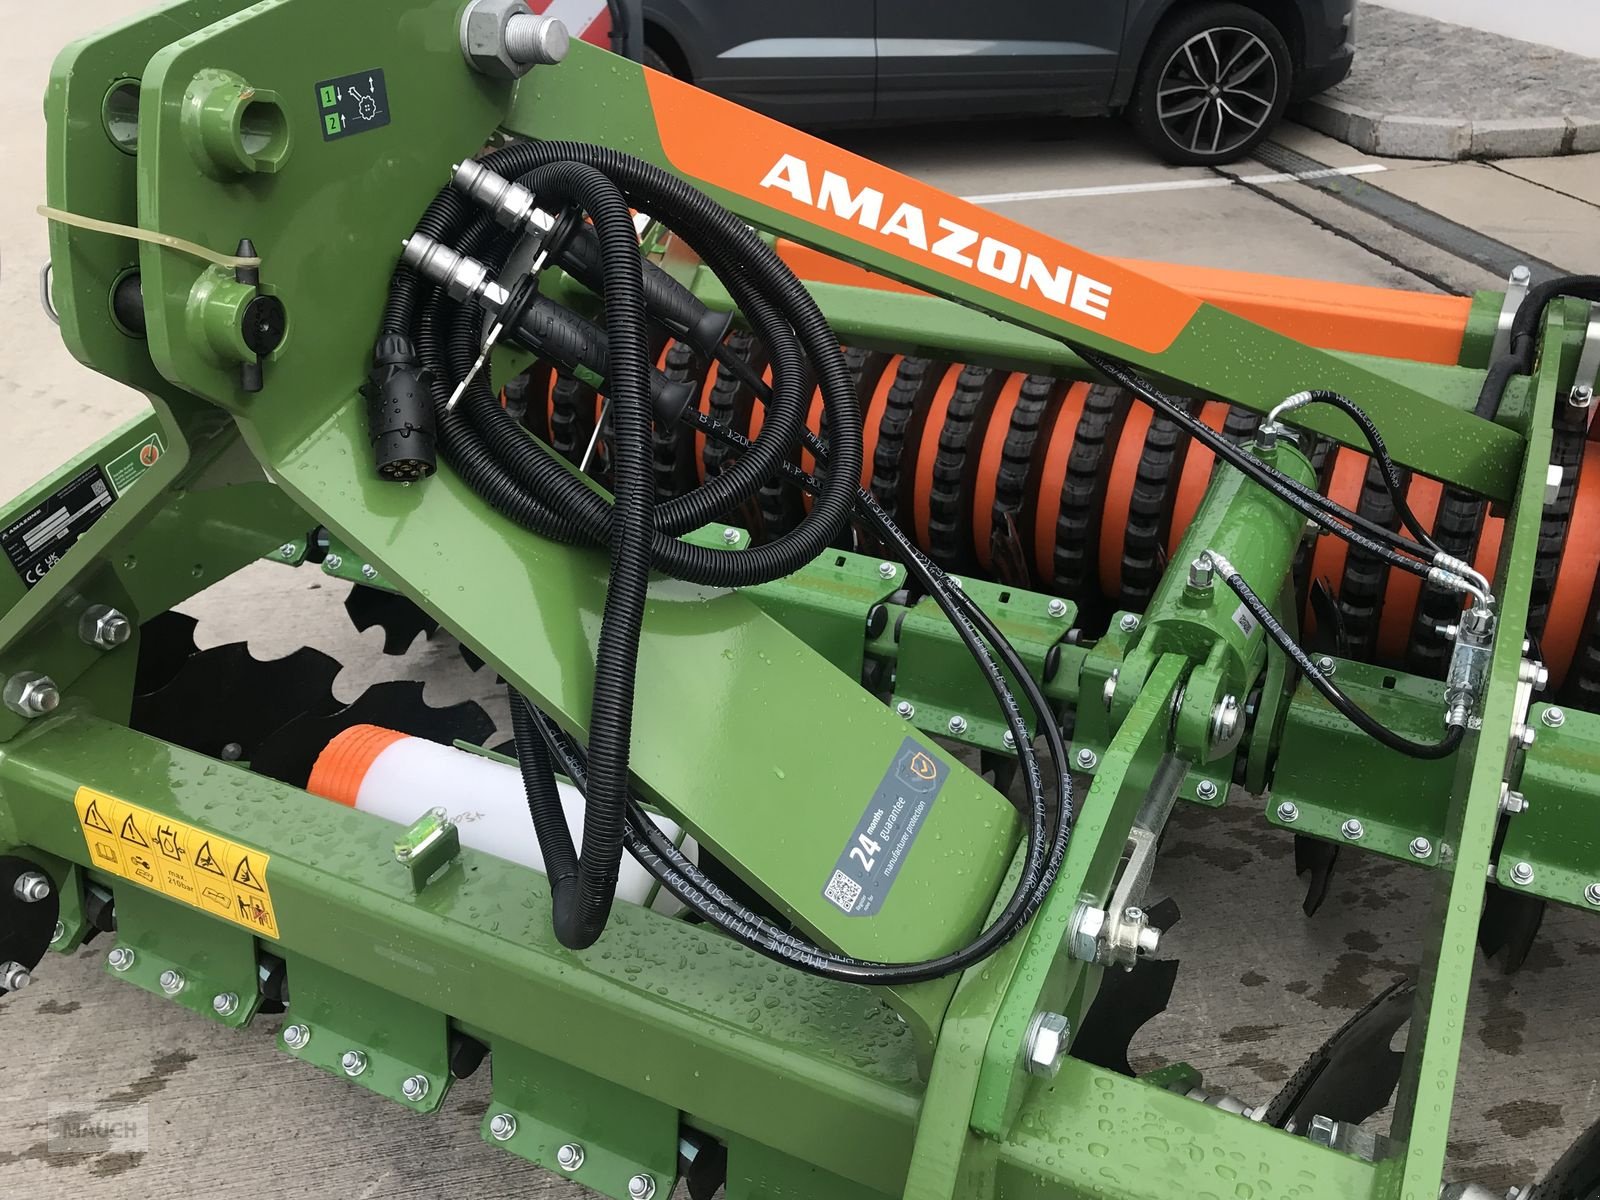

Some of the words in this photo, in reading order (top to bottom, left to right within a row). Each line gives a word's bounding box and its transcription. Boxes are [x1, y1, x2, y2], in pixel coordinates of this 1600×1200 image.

[325, 90, 332, 103] 1
[329, 117, 336, 130] 2
[760, 153, 1113, 321] AMAZONE
[1273, 483, 1311, 511] AMAZONE
[1279, 632, 1322, 679] AMAZONE
[866, 808, 884, 836] months
[879, 796, 907, 842] guarantee
[849, 832, 882, 873] 24
[883, 831, 910, 877] manufacturer
[906, 800, 926, 836] protection
[168, 870, 188, 882] max.
[168, 876, 194, 893] 210bar
[662, 868, 760, 942] MTH1P37000AM
[763, 936, 829, 970] AMAZONE
